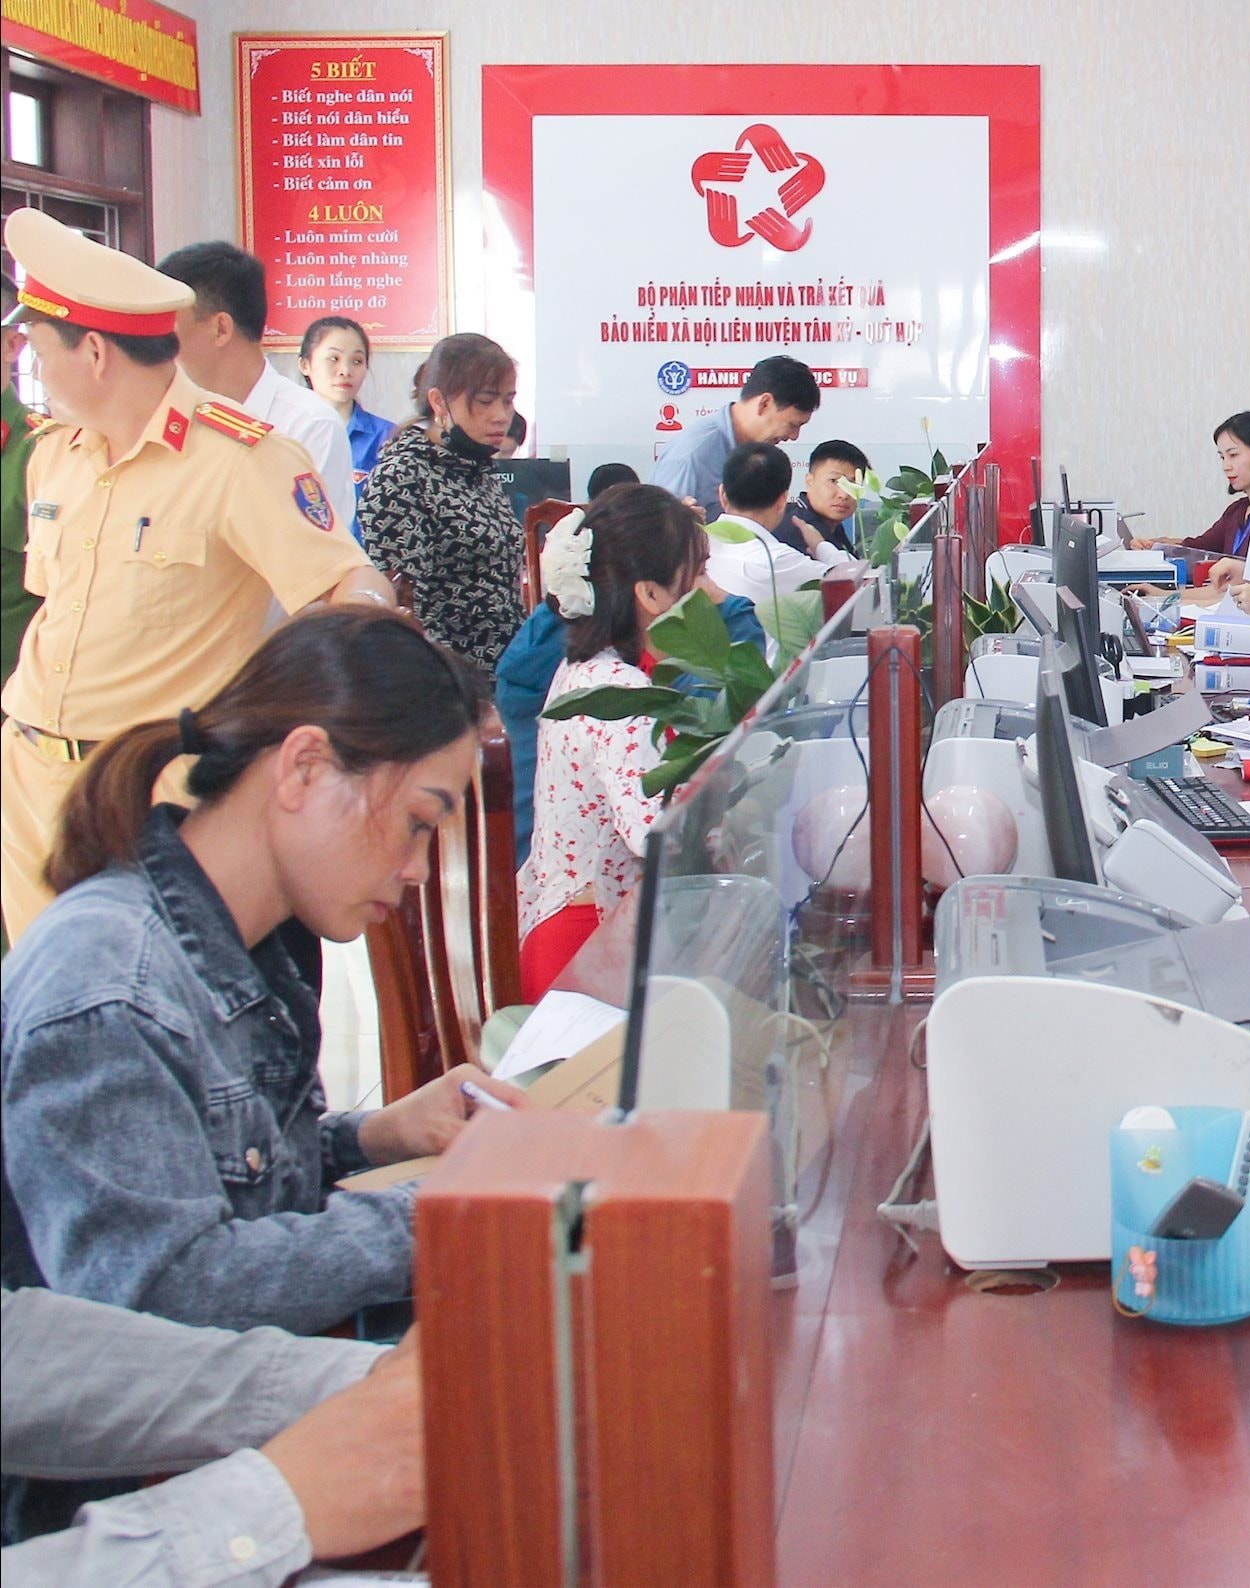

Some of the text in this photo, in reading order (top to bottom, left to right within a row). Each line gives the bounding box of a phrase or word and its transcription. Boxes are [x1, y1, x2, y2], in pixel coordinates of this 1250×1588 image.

[311, 55, 376, 78] 5 BIẾT
[282, 88, 413, 106] Biết nghe dân nói
[282, 108, 409, 124] Biết nói dân hiểu
[283, 131, 402, 146] Biết làm dân tin
[283, 152, 364, 168] Biết xin lỗi
[284, 175, 372, 190] Biết cảm ơn
[309, 201, 383, 221] 4 LUÔN
[285, 230, 398, 243] Luôn mỉm cười
[286, 252, 408, 267] Luôn nhẹ nhàng
[287, 272, 402, 289] Luôn lắng nghe
[638, 281, 656, 310] BỘ
[660, 281, 697, 310] PHẬN
[702, 277, 731, 306] TIẾP
[736, 281, 773, 310] NHẬN
[778, 282, 795, 306] VÀ
[799, 278, 824, 306] TRẢ
[829, 276, 853, 306] KẾT
[287, 296, 386, 311] Luôn giúp đỡ
[600, 315, 629, 342] BẢO
[633, 312, 667, 342] HIỂM
[672, 317, 690, 342] XÃ
[694, 317, 716, 346] HỘI
[721, 317, 751, 342] LIÊN
[755, 317, 800, 346] HUYỆN
[805, 317, 831, 342] TÂN
[698, 370, 738, 384] HÀNH
[839, 371, 857, 386] VỤ
